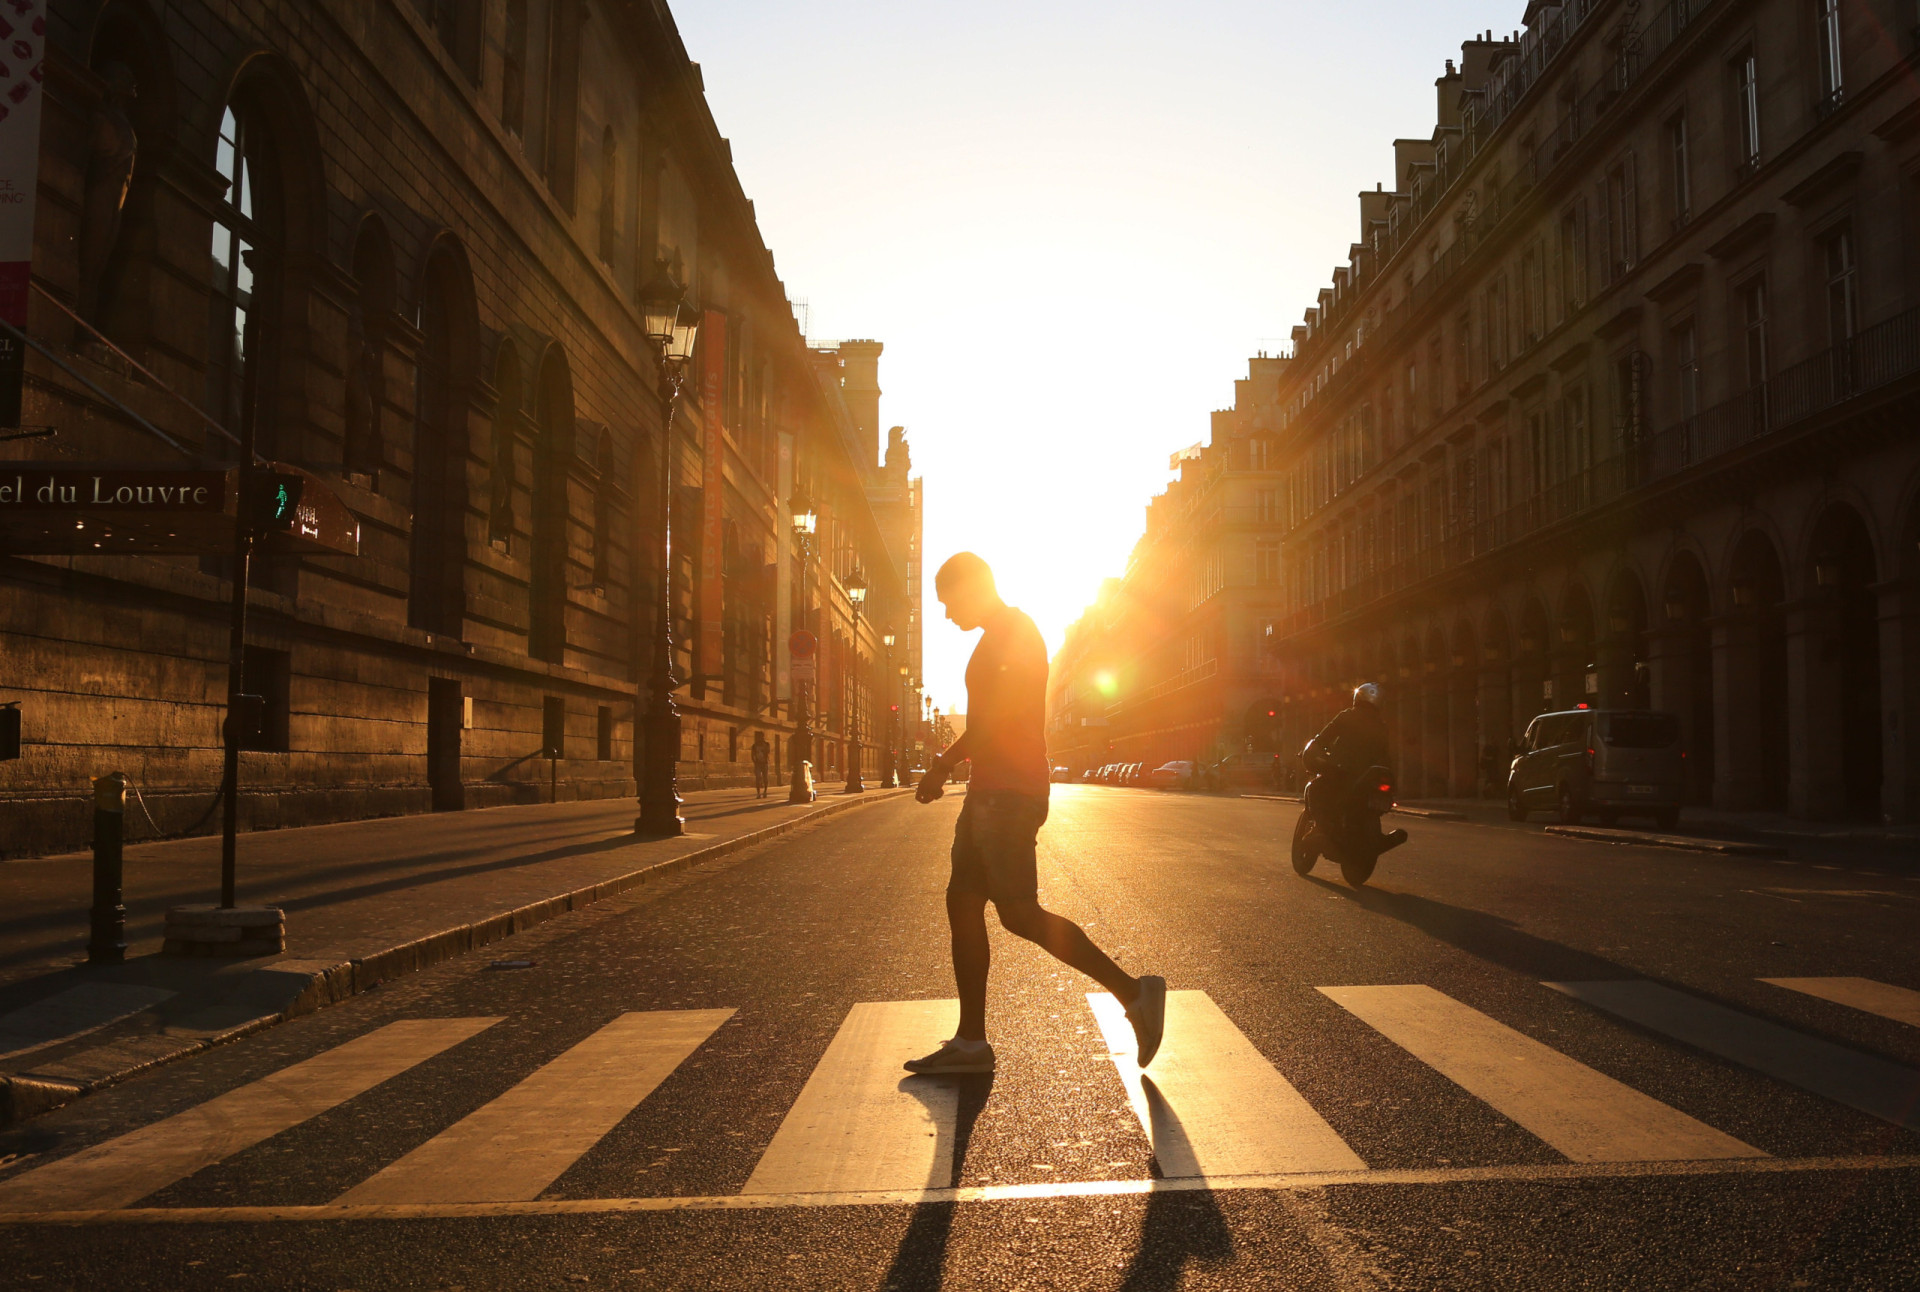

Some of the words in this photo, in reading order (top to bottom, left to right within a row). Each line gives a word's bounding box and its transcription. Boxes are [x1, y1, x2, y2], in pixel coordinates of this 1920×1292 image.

[0, 475, 24, 504] el
[36, 474, 78, 504] du
[90, 475, 209, 505] Louvre
[703, 493, 716, 537] Arts
[703, 546, 716, 580] Les
